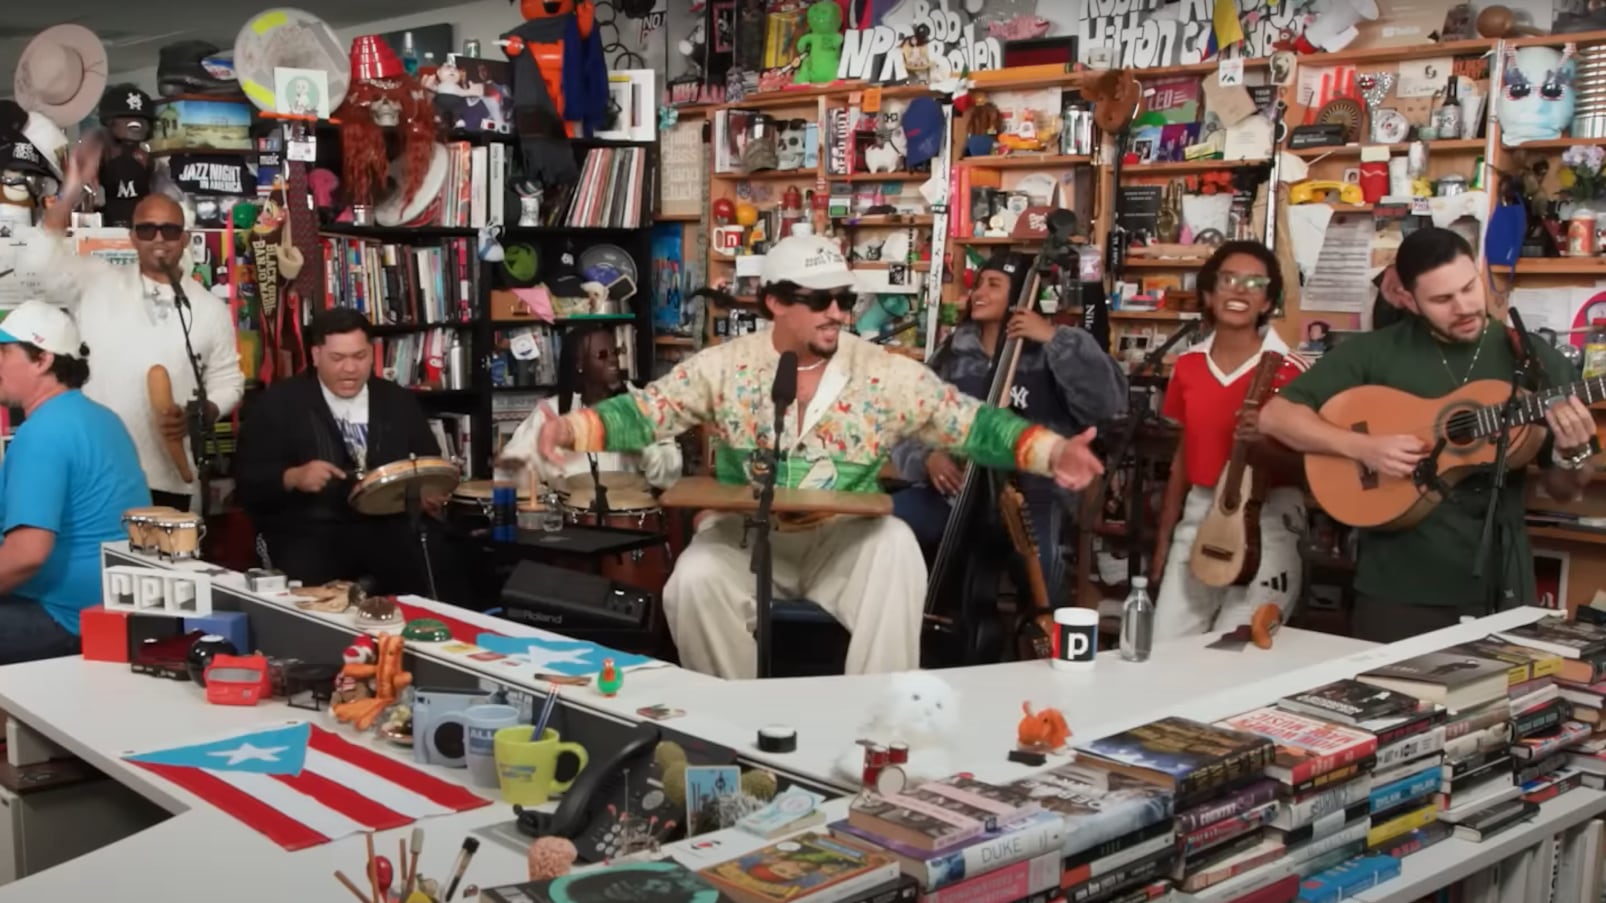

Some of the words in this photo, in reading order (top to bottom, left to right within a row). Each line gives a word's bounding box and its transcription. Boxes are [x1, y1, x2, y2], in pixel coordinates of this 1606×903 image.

[914, 0, 961, 43] Bob
[837, 26, 909, 81] NPR
[927, 24, 1001, 81] Boilen
[1079, 11, 1178, 69] Hilton
[179, 163, 209, 181] JAZZ
[209, 163, 241, 181] NIGHT
[117, 180, 138, 198] M
[524, 610, 562, 624] Roland
[1067, 632, 1089, 660] p
[981, 836, 1023, 864] DUKE
